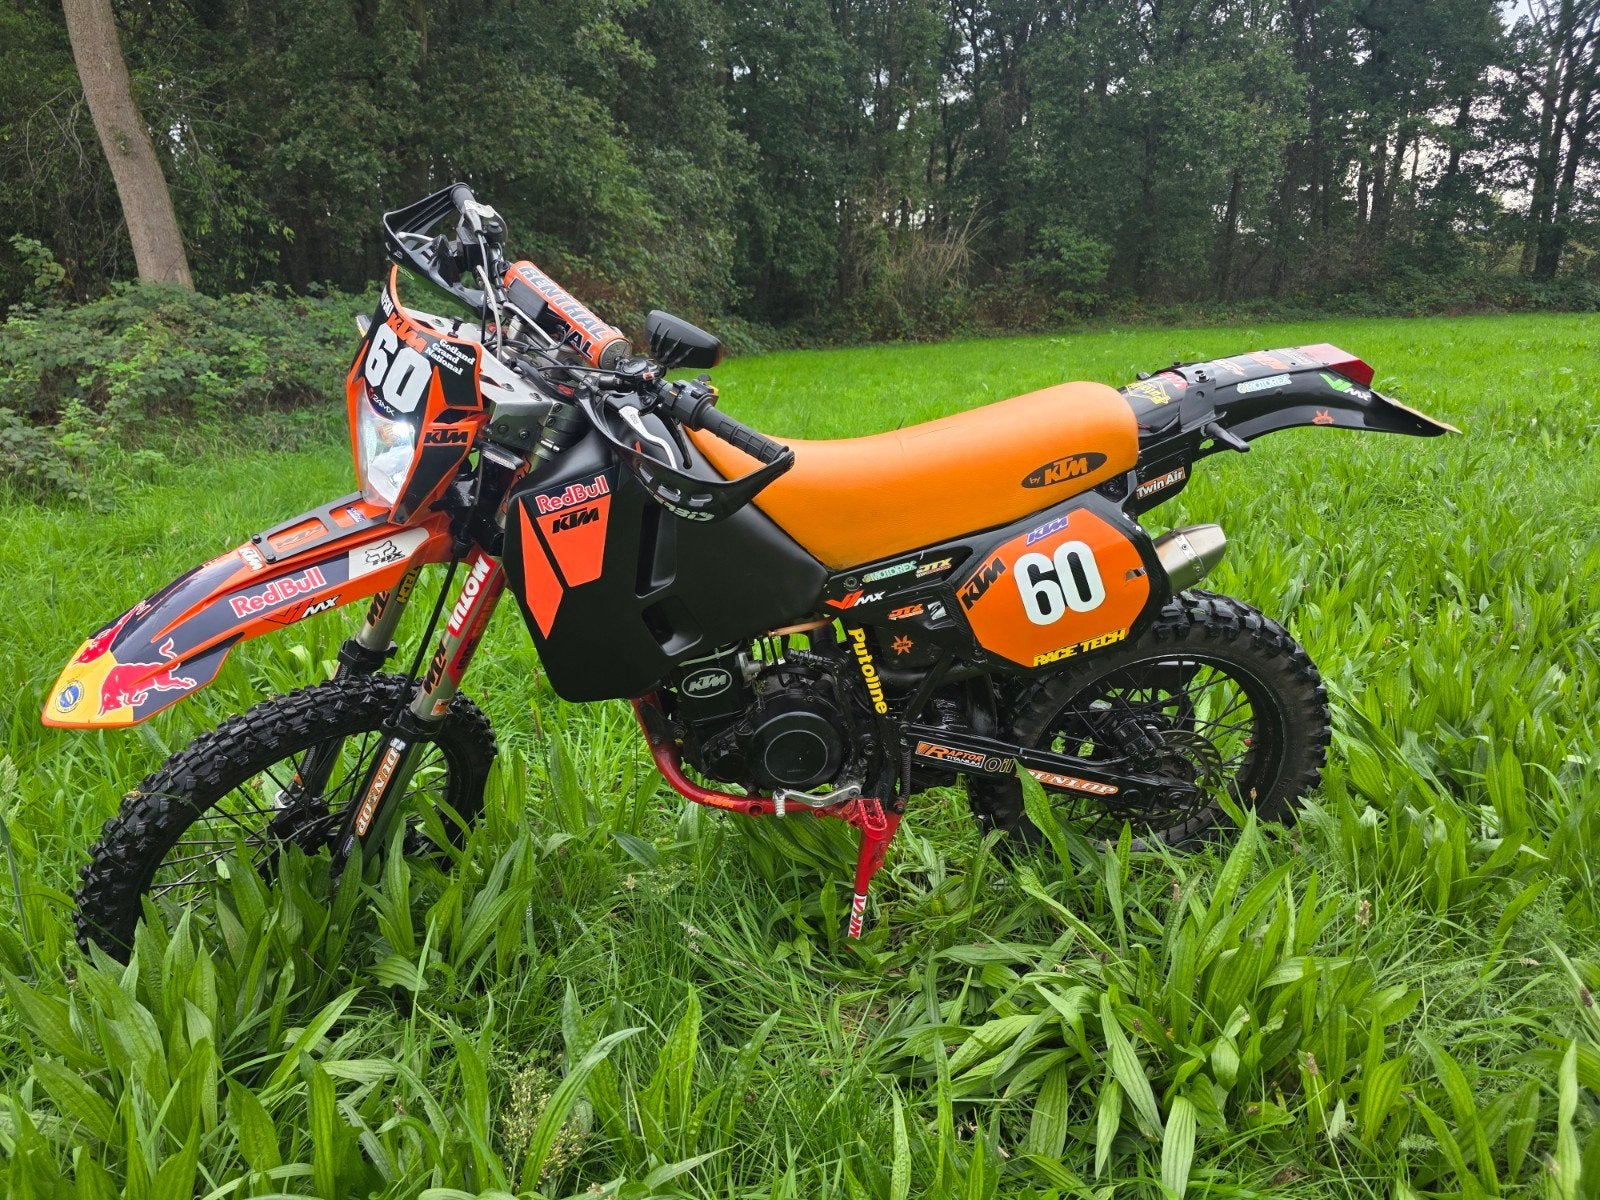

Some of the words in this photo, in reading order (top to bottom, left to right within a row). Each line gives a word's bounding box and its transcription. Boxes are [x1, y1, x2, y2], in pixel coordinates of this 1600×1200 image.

[517, 266, 606, 341] RENTHAL
[386, 312, 427, 353] KTM
[426, 346, 464, 375] National
[431, 342, 459, 364] Grand
[439, 338, 476, 365] Gotland
[365, 322, 432, 413] 60
[424, 428, 469, 443] KTM
[1044, 457, 1088, 486] KTM
[1136, 480, 1164, 499] Twin
[1166, 467, 1185, 486] Air
[552, 507, 599, 534] KTM
[1026, 516, 1069, 546] KTM
[238, 547, 264, 571] KTM
[870, 560, 917, 582] MOTOREX
[448, 554, 490, 631] MOTUL
[961, 557, 1007, 611] KTM
[1013, 540, 1106, 626] 60
[1033, 643, 1079, 667] RACE
[1080, 628, 1127, 653] TECH
[423, 639, 447, 695] KTM
[848, 628, 887, 714] Putoline
[688, 673, 727, 692] KTM
[945, 755, 981, 767] TITANIUM
